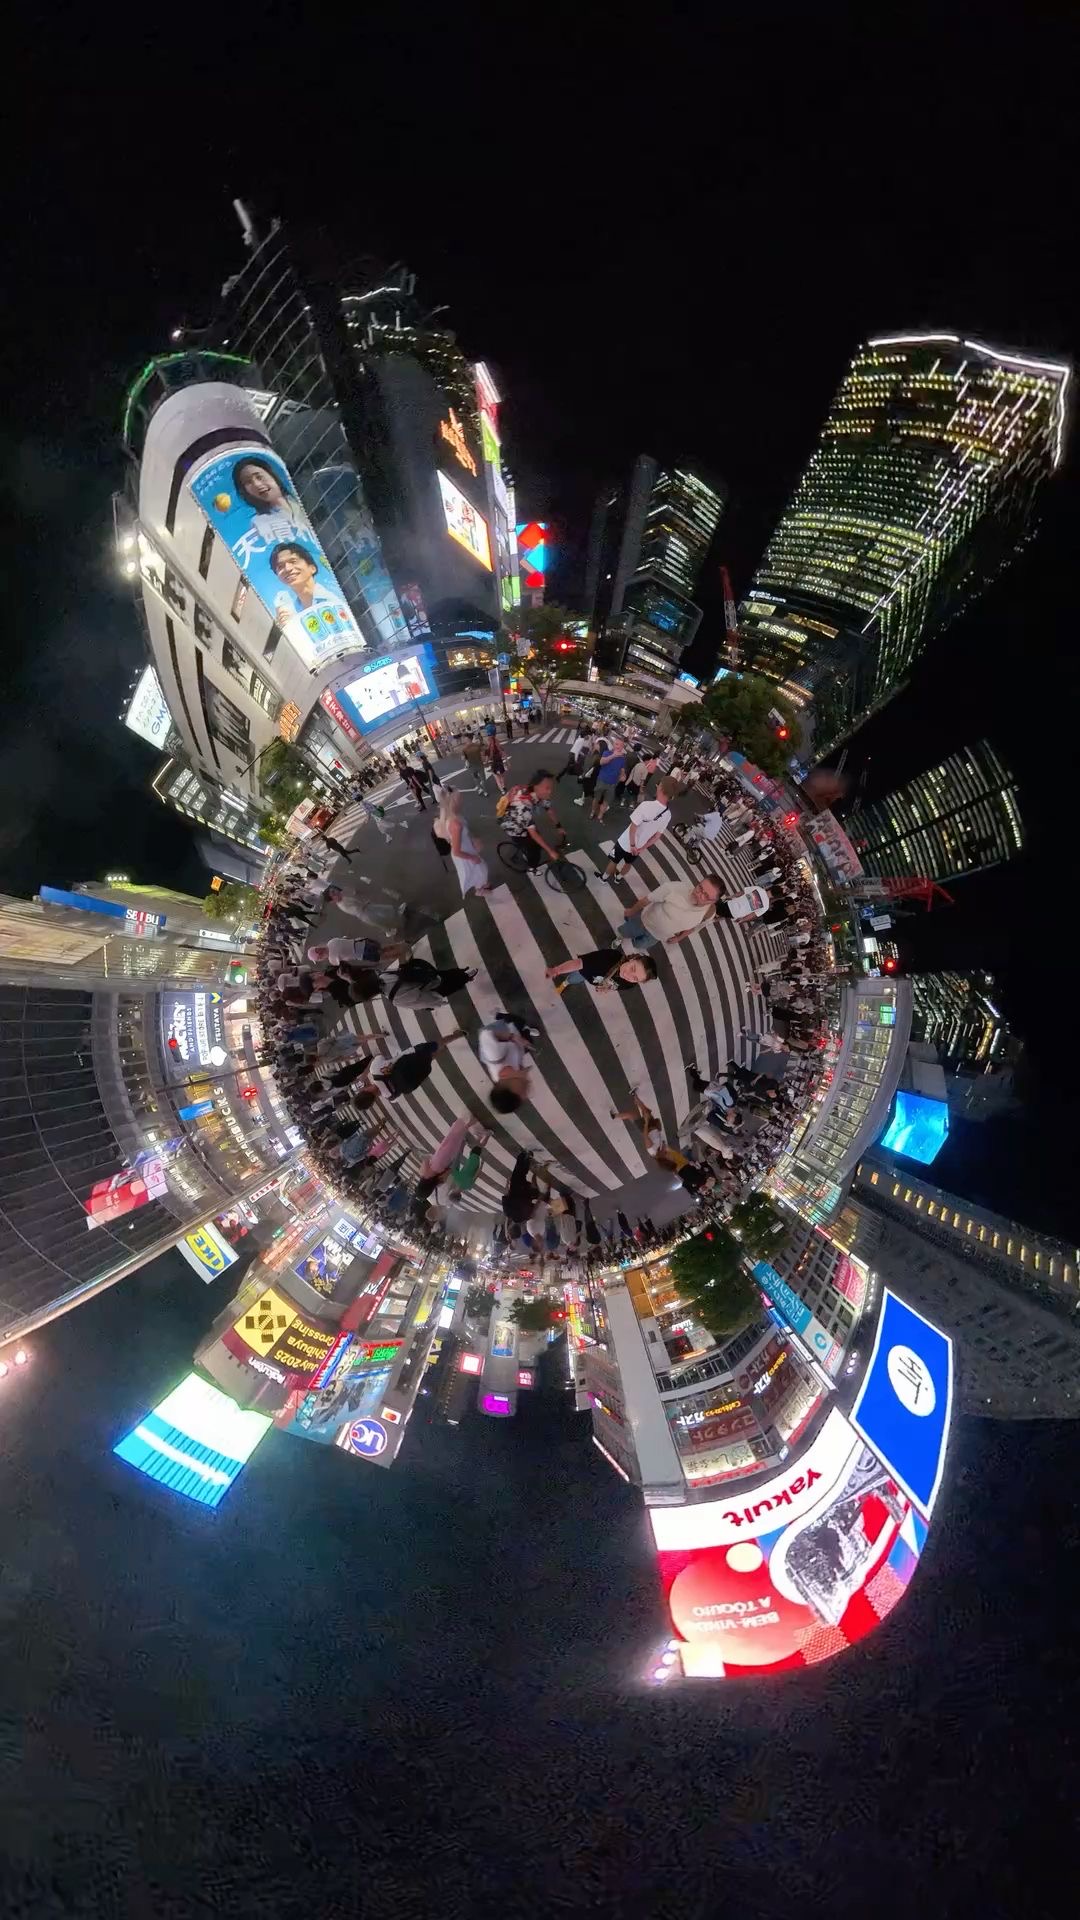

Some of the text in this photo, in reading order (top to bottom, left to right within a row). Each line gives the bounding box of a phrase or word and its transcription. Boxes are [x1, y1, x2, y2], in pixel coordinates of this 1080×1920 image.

[126, 908, 159, 926] SEIBU
[171, 1001, 189, 1059] MICKEY
[212, 1008, 221, 1041] TSUTAYA
[213, 1085, 258, 1163] STARBUCKS
[765, 1270, 805, 1316] アイシティ
[290, 1318, 335, 1346] Crossing
[286, 1334, 327, 1359] Shibuya
[247, 1356, 285, 1384] Rakuten
[750, 1372, 771, 1395] ガスト
[675, 1410, 705, 1426] ガスト
[691, 1413, 755, 1442] コンタクト
[685, 1453, 729, 1474] しゃぶ葉
[722, 1468, 821, 1527] Yakult
[693, 1596, 771, 1617] A TÓQUIO
